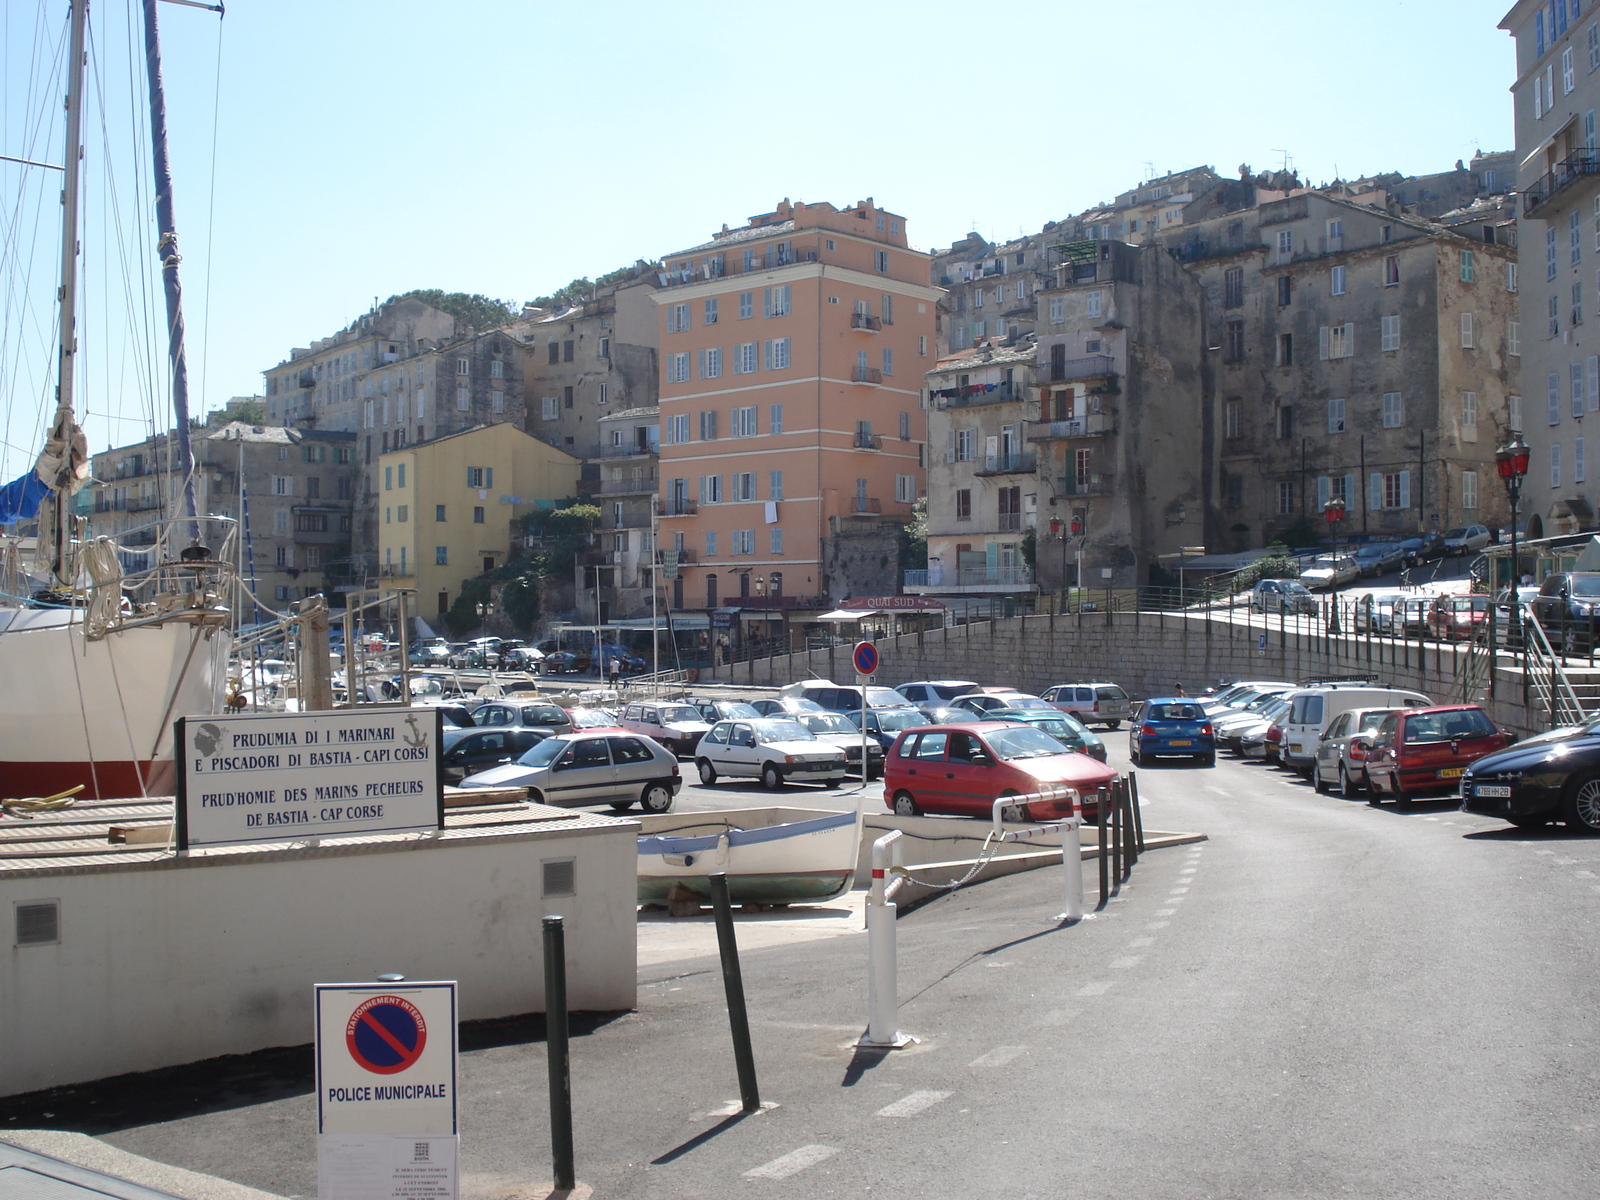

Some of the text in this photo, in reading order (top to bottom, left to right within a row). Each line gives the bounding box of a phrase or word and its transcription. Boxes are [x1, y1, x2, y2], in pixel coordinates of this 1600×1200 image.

[867, 597, 892, 608] QUAI
[894, 598, 915, 607] SUD
[232, 727, 395, 748] PRUDUMIA DI I MARINARI
[195, 759, 203, 772] E
[211, 754, 280, 771] PISCADORI
[288, 754, 301, 767] DI
[310, 751, 352, 766] BASTIA
[363, 749, 390, 762] CAPI
[394, 747, 429, 760] CORSI
[202, 780, 424, 807] PRUD'HOMIE DES MARINS PECHEURS
[246, 813, 263, 827] DE
[267, 810, 309, 825] BASTIA
[320, 808, 343, 821] CAP
[346, 805, 384, 819] CORSE
[347, 996, 425, 1036] STATIONNEMENT INTERDIT
[329, 1084, 446, 1102] POLICE MUNICIPALE
